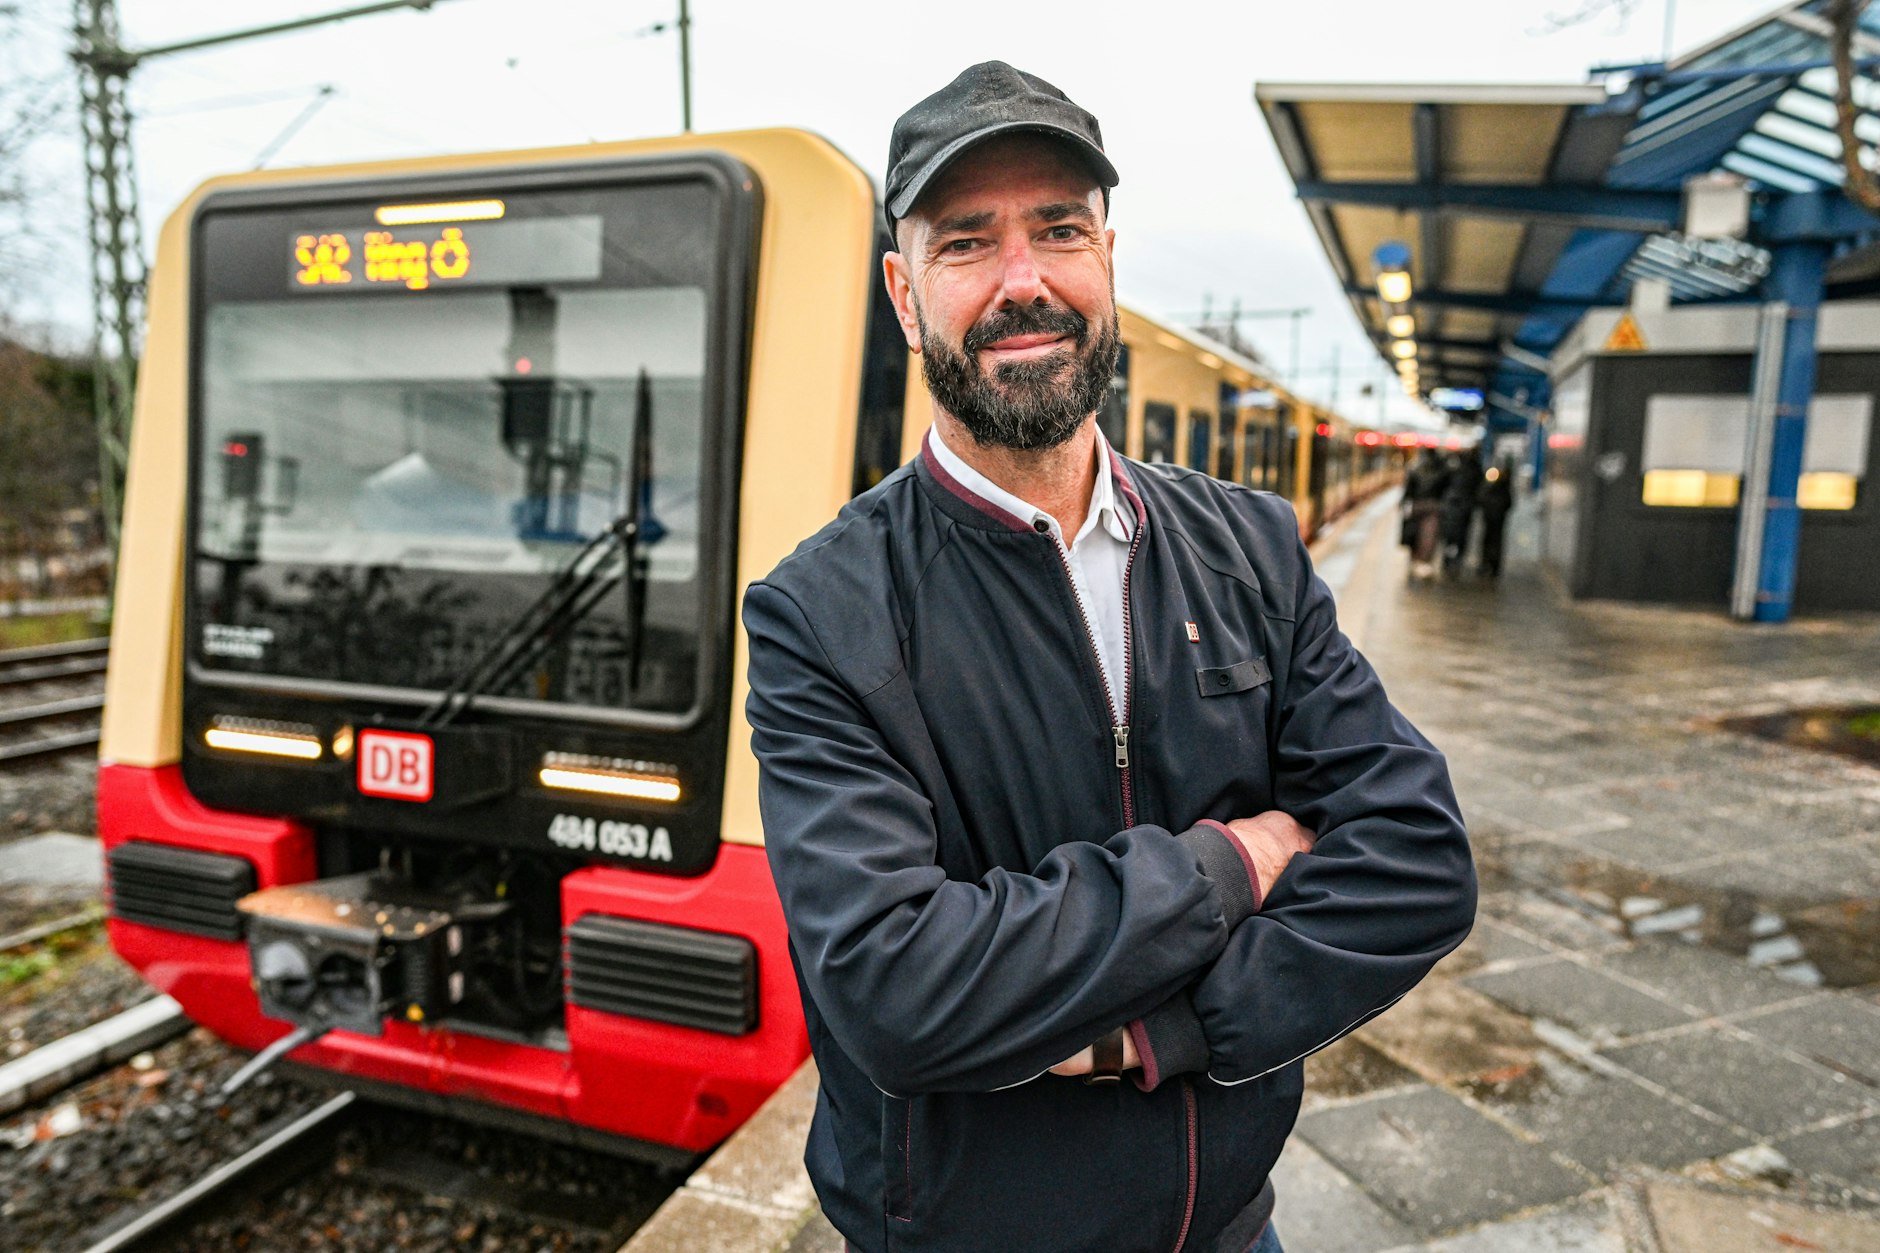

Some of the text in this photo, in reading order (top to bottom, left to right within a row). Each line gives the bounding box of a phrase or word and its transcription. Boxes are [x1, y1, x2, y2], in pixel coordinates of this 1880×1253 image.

[370, 743, 421, 786] DB
[547, 813, 673, 862] 484 053 A
